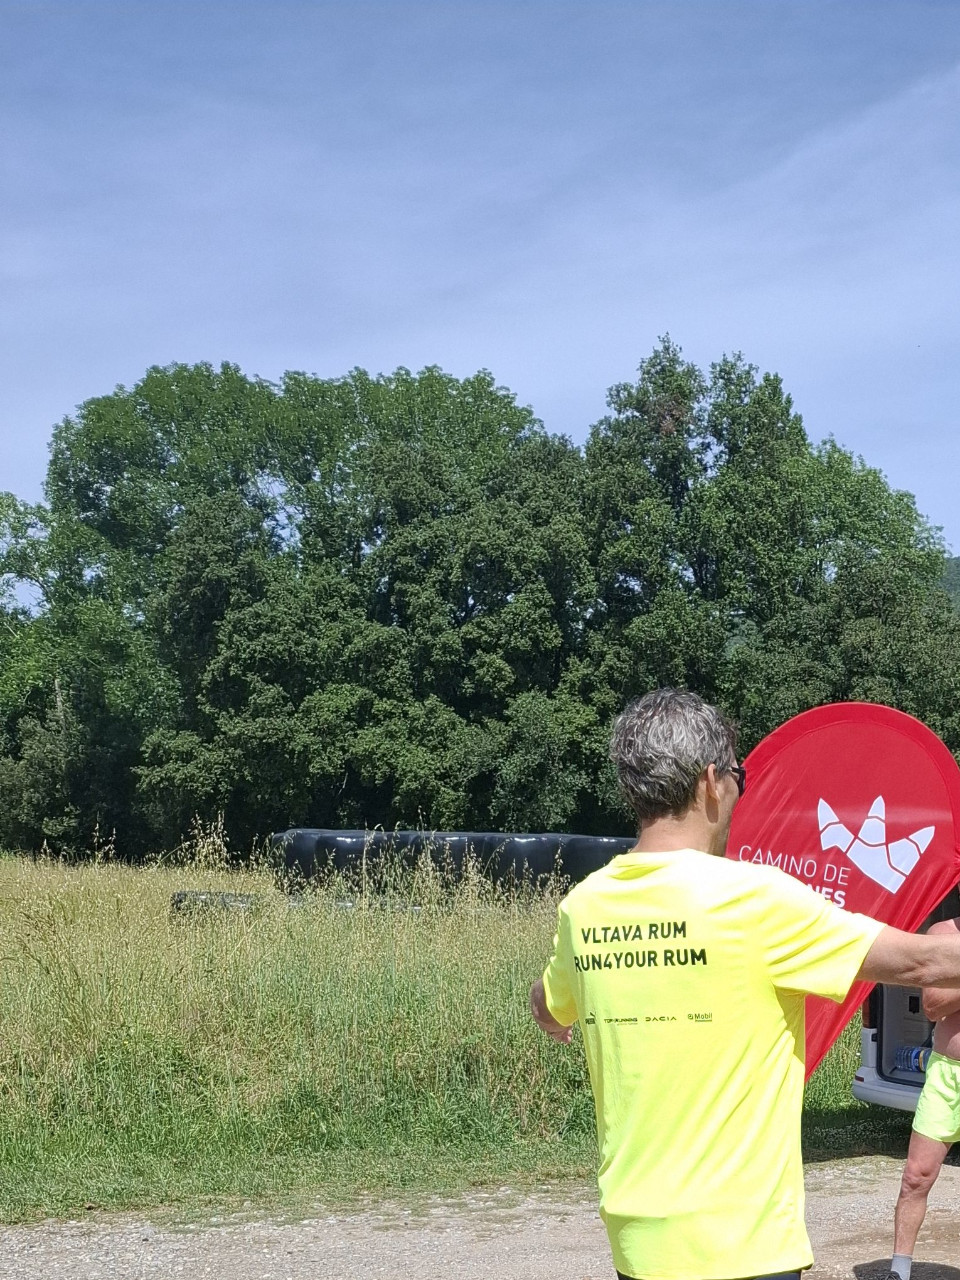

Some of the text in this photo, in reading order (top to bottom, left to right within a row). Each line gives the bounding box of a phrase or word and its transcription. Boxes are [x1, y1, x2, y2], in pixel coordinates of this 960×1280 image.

[738, 845, 851, 886] CAMINO DE
[581, 921, 686, 944] VLTAVA RUM
[574, 948, 707, 973] RUN4YOUR RUM
